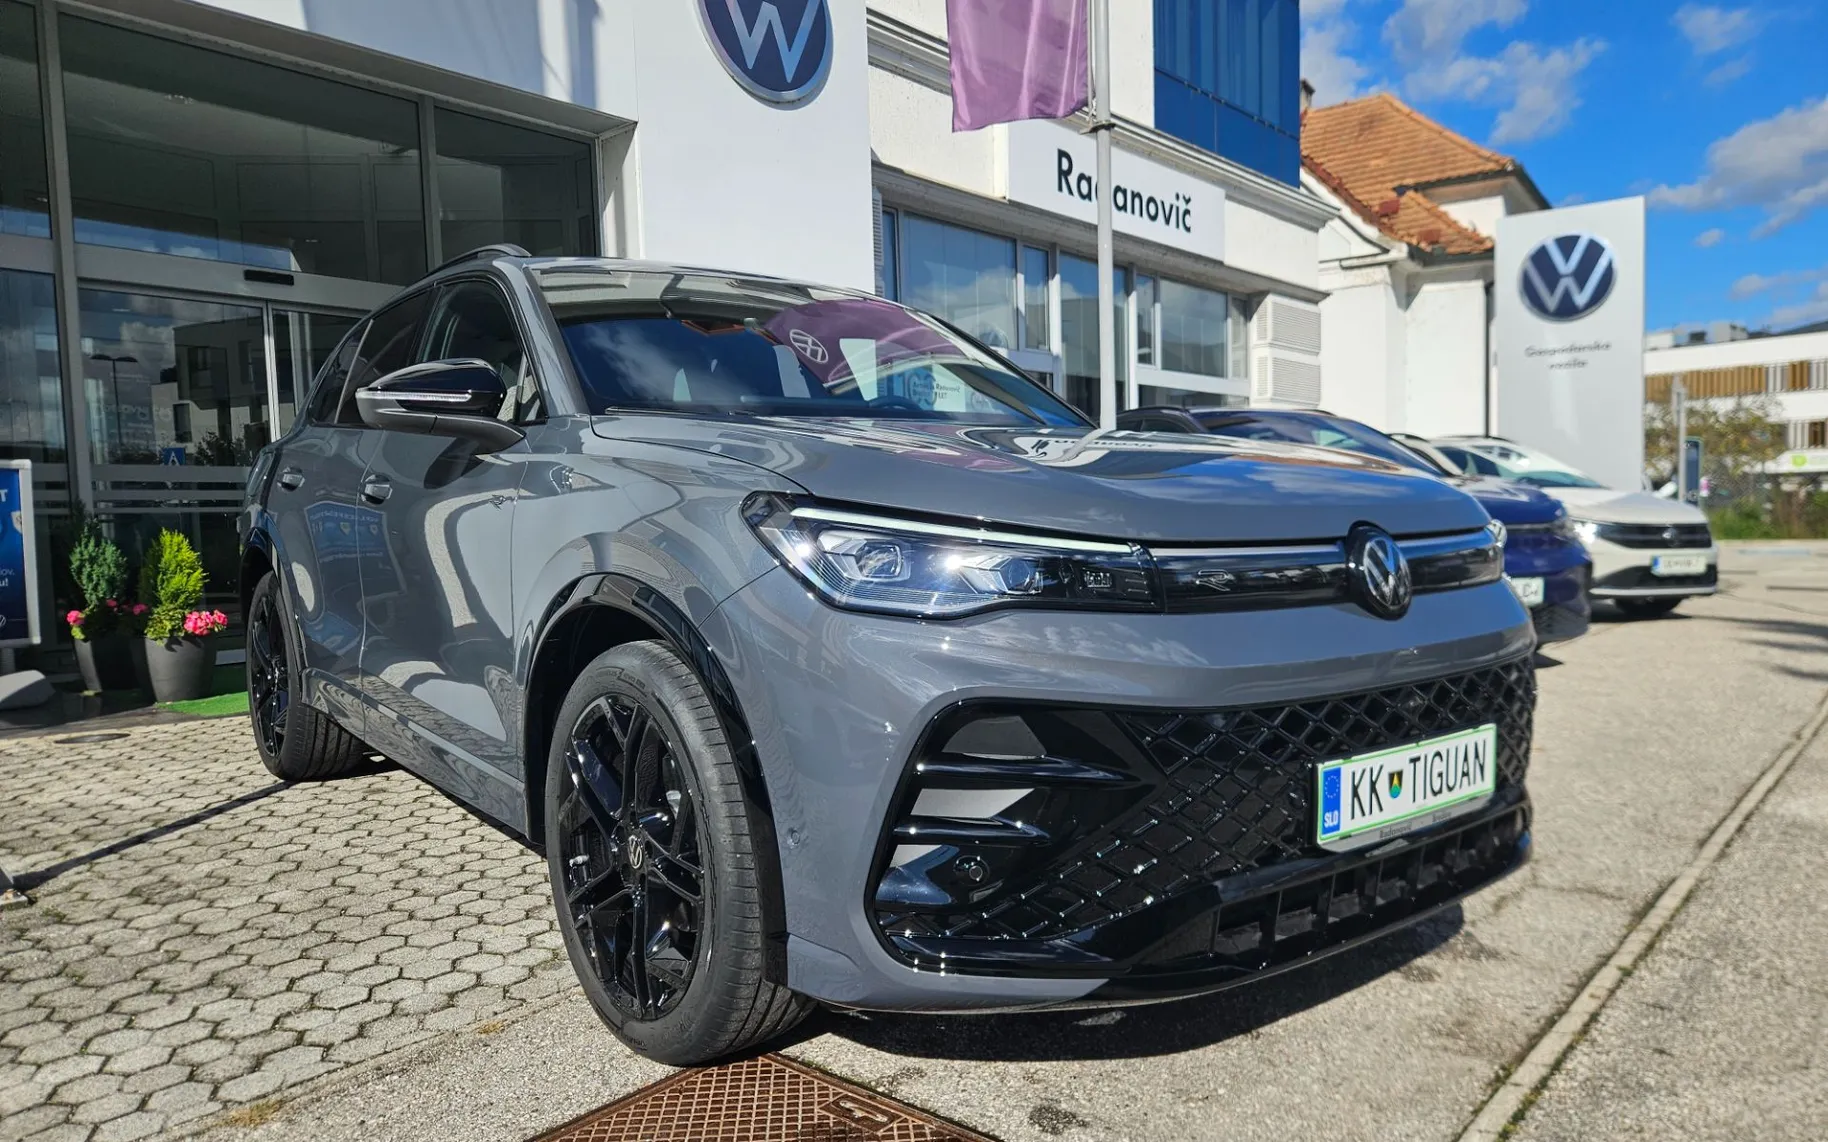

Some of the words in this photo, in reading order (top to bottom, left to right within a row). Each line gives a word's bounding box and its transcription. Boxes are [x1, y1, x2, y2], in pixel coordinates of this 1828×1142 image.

[1057, 148, 1192, 233] Raanovič
[1324, 809, 1339, 828] SLO
[1350, 764, 1384, 820] KK
[1408, 738, 1487, 803] TIGUAN
